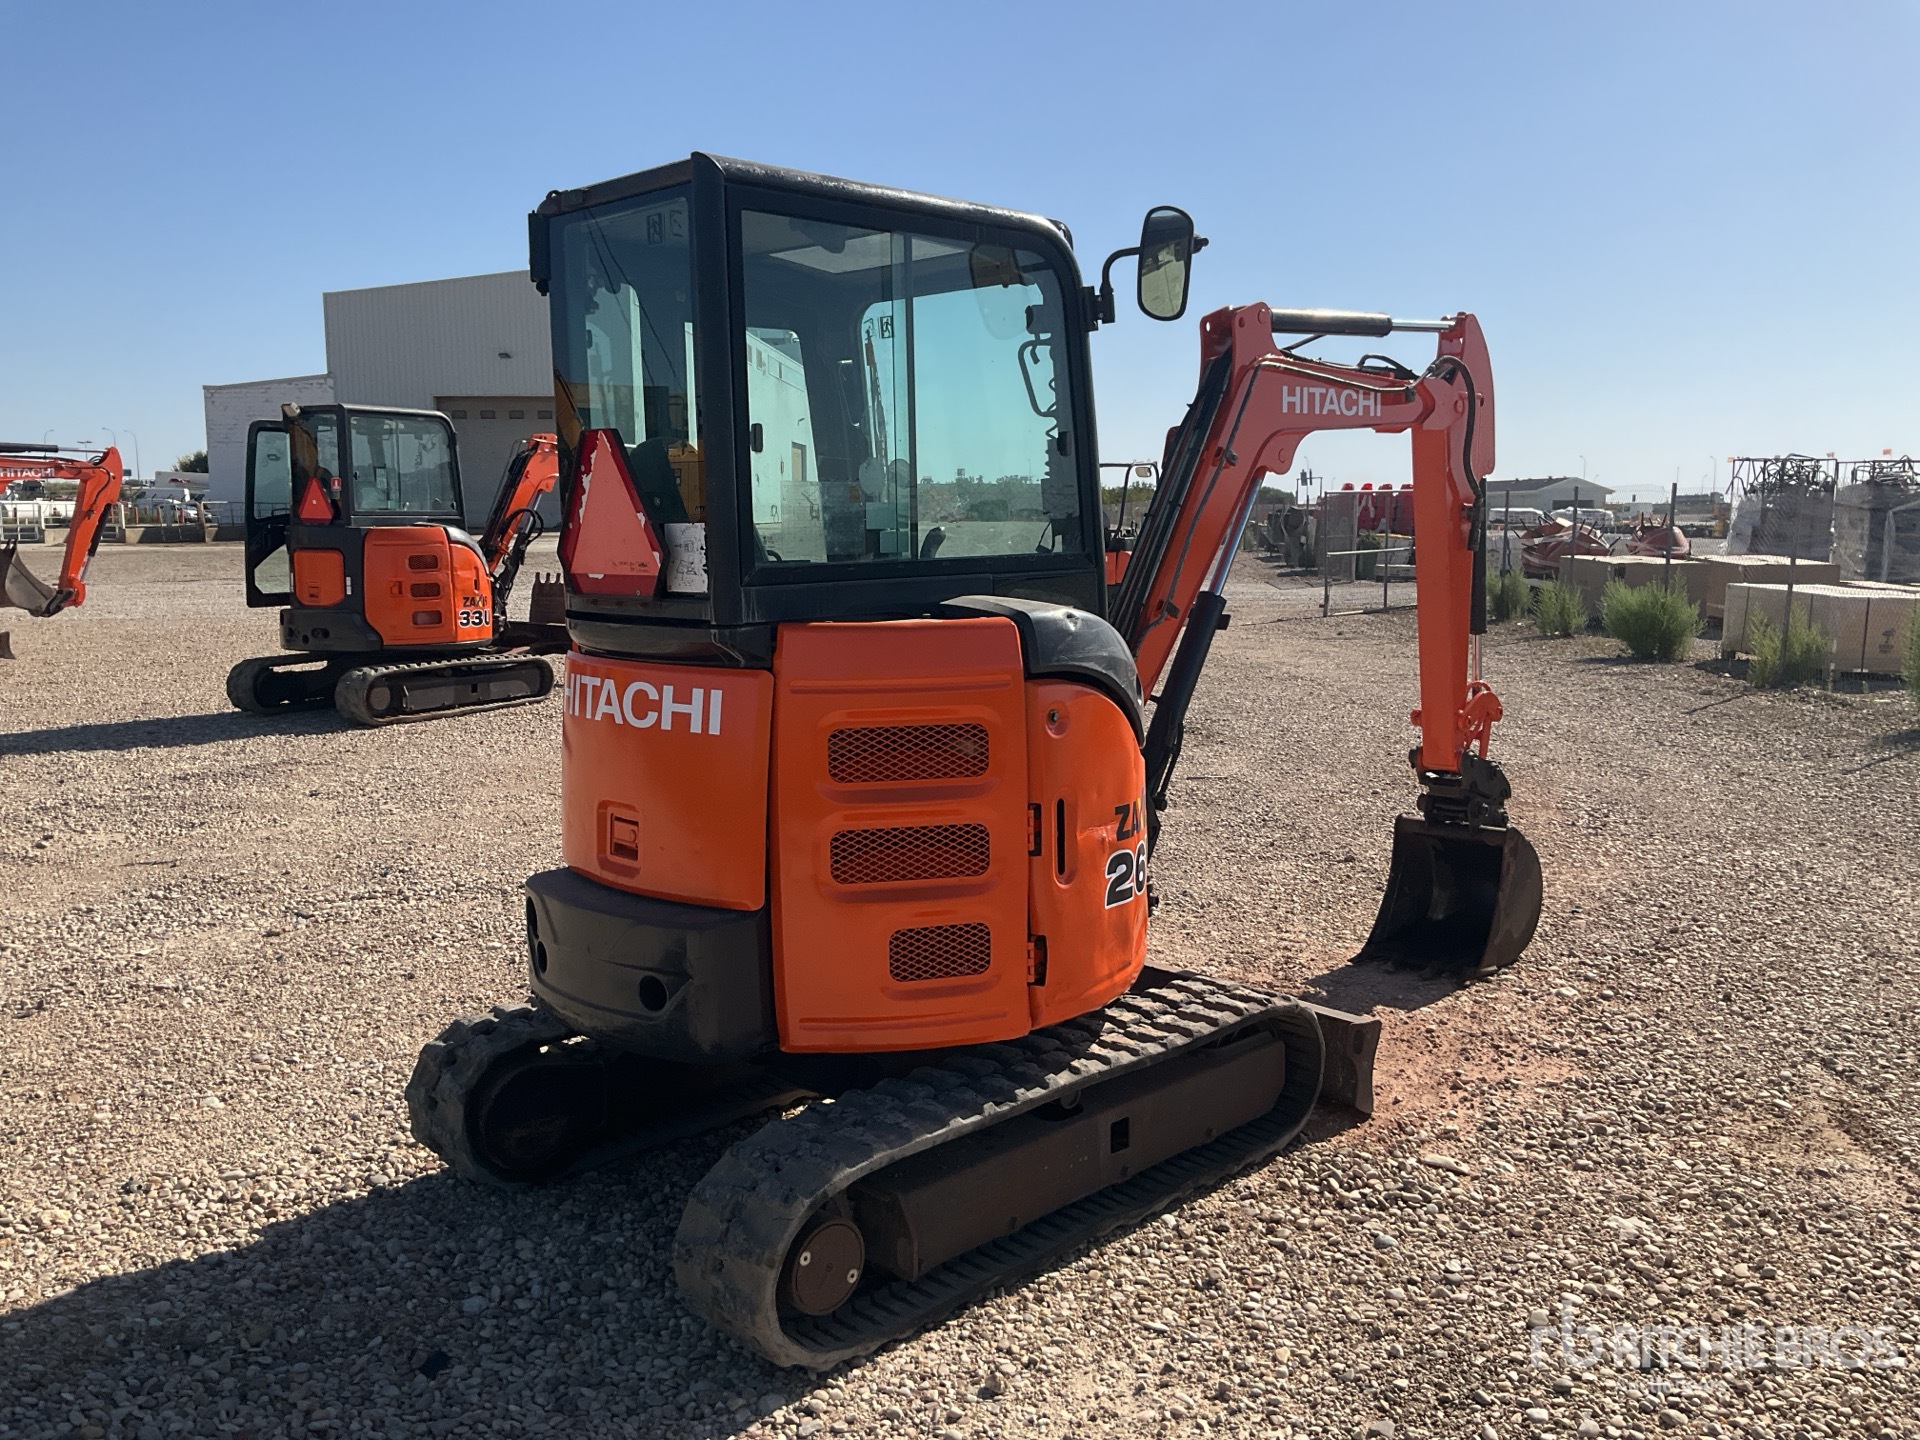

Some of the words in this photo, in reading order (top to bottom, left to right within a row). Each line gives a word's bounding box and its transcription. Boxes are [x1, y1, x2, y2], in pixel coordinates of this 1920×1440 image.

[1282, 385, 1381, 417] HITACHI
[0, 467, 55, 478] HITACHI
[564, 673, 723, 735] HITACHI
